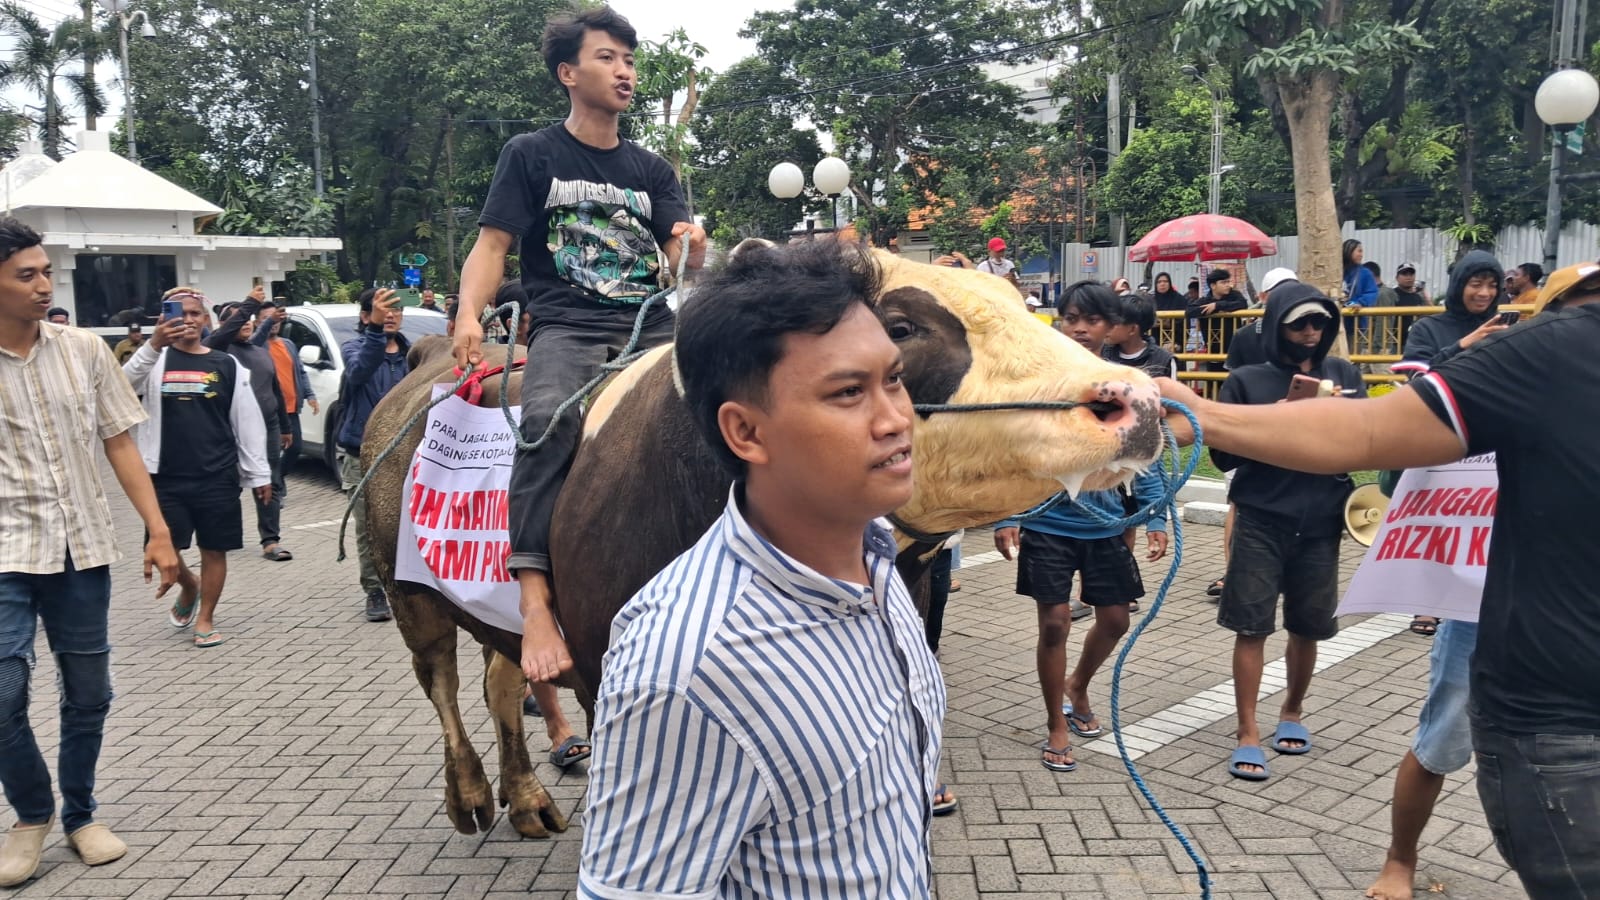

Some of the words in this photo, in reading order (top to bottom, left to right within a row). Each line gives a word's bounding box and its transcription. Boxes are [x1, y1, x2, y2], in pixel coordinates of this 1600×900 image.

[431, 420, 457, 440] PARA
[459, 434, 489, 444] JAGAL
[491, 432, 512, 442] DAN
[428, 439, 467, 461] DAGING
[1386, 487, 1498, 523] JANGAN
[1376, 525, 1461, 566] RIZKI
[1466, 527, 1491, 566] K
